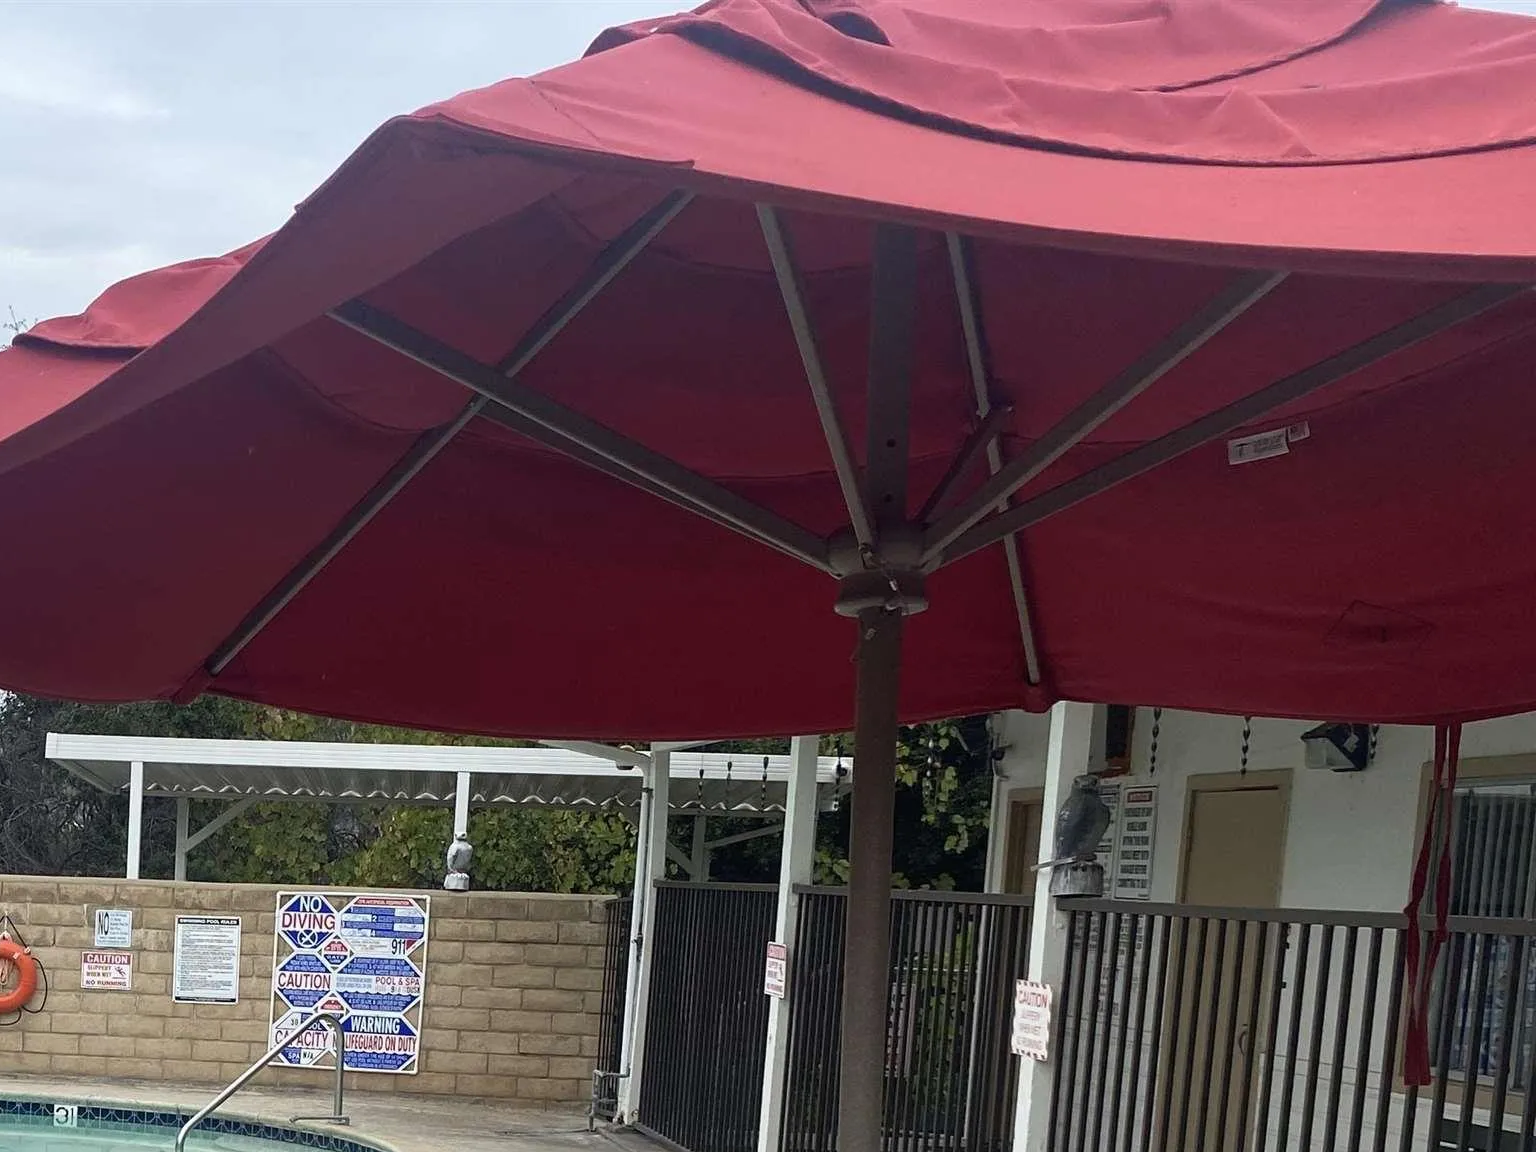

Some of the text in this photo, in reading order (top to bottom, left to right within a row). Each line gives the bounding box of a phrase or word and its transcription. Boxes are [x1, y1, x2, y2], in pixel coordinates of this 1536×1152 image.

[300, 896, 322, 912] NO
[98, 912, 109, 935] NO
[282, 913, 335, 930] DIVING
[392, 940, 405, 954] 911
[87, 954, 128, 964] CAUTION
[279, 973, 331, 988] CAUTION
[376, 977, 396, 985] POOL
[1019, 990, 1048, 1008] CAUTION
[351, 1016, 400, 1034] WARNING
[276, 1030, 329, 1047] CAACITY
[346, 1034, 384, 1050] LIFEGUARD
[385, 1036, 396, 1051] ON
[398, 1037, 417, 1052] DUTY
